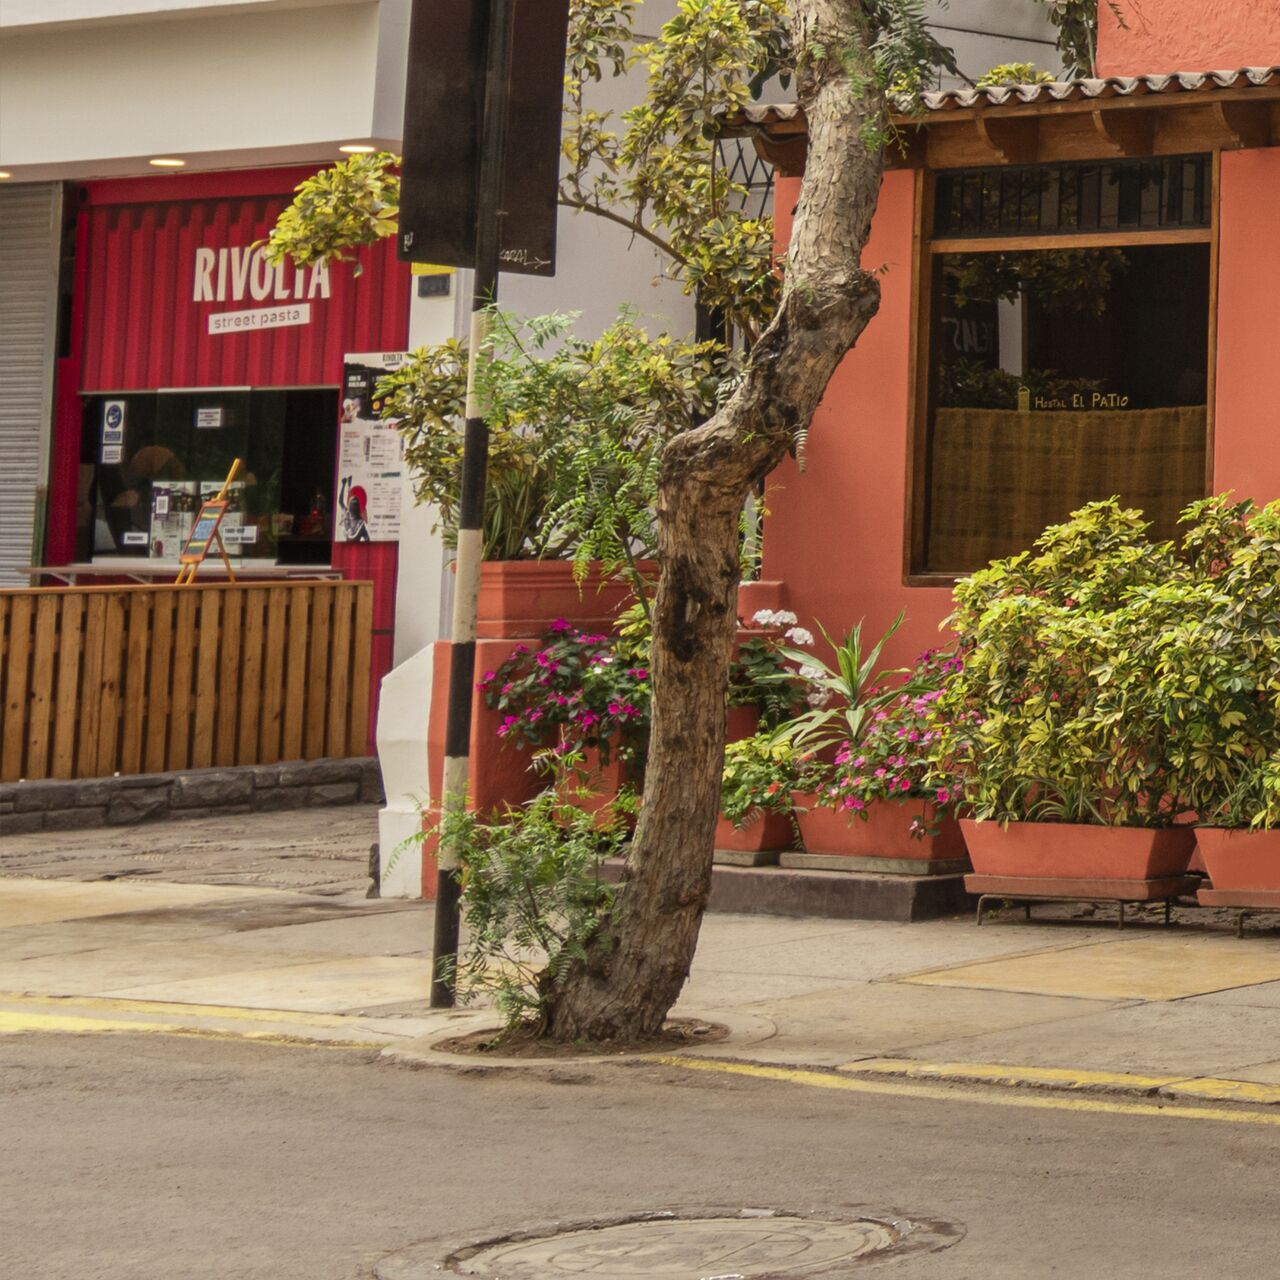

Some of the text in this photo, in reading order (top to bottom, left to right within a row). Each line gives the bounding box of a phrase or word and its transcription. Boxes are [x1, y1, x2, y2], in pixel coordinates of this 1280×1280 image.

[214, 309, 301, 329] street pasta
[1072, 393, 1085, 407] EL
[1092, 392, 1129, 408] PATIO
